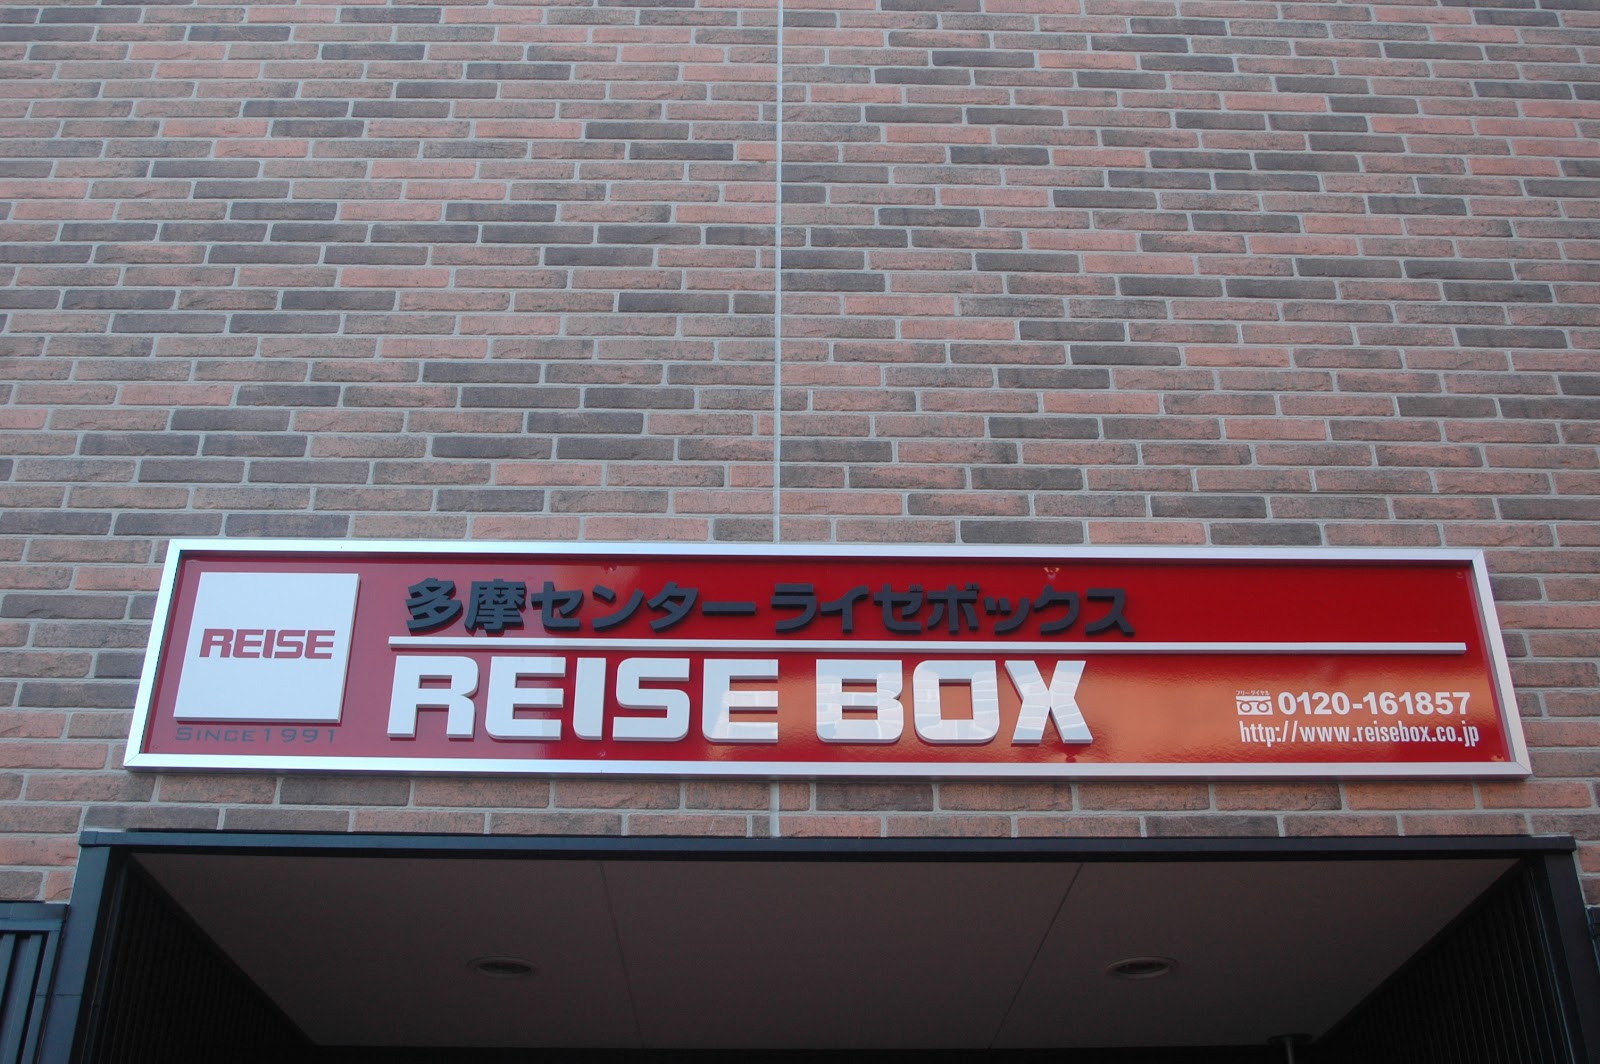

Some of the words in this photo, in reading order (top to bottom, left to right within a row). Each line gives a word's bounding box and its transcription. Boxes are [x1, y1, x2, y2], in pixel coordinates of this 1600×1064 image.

[199, 628, 335, 659] REISE
[386, 655, 779, 743] REISE
[815, 658, 1094, 745] BOX
[1277, 691, 1471, 715] 0120-161857
[1238, 719, 1480, 748] http://www.reisebox.co.jp
